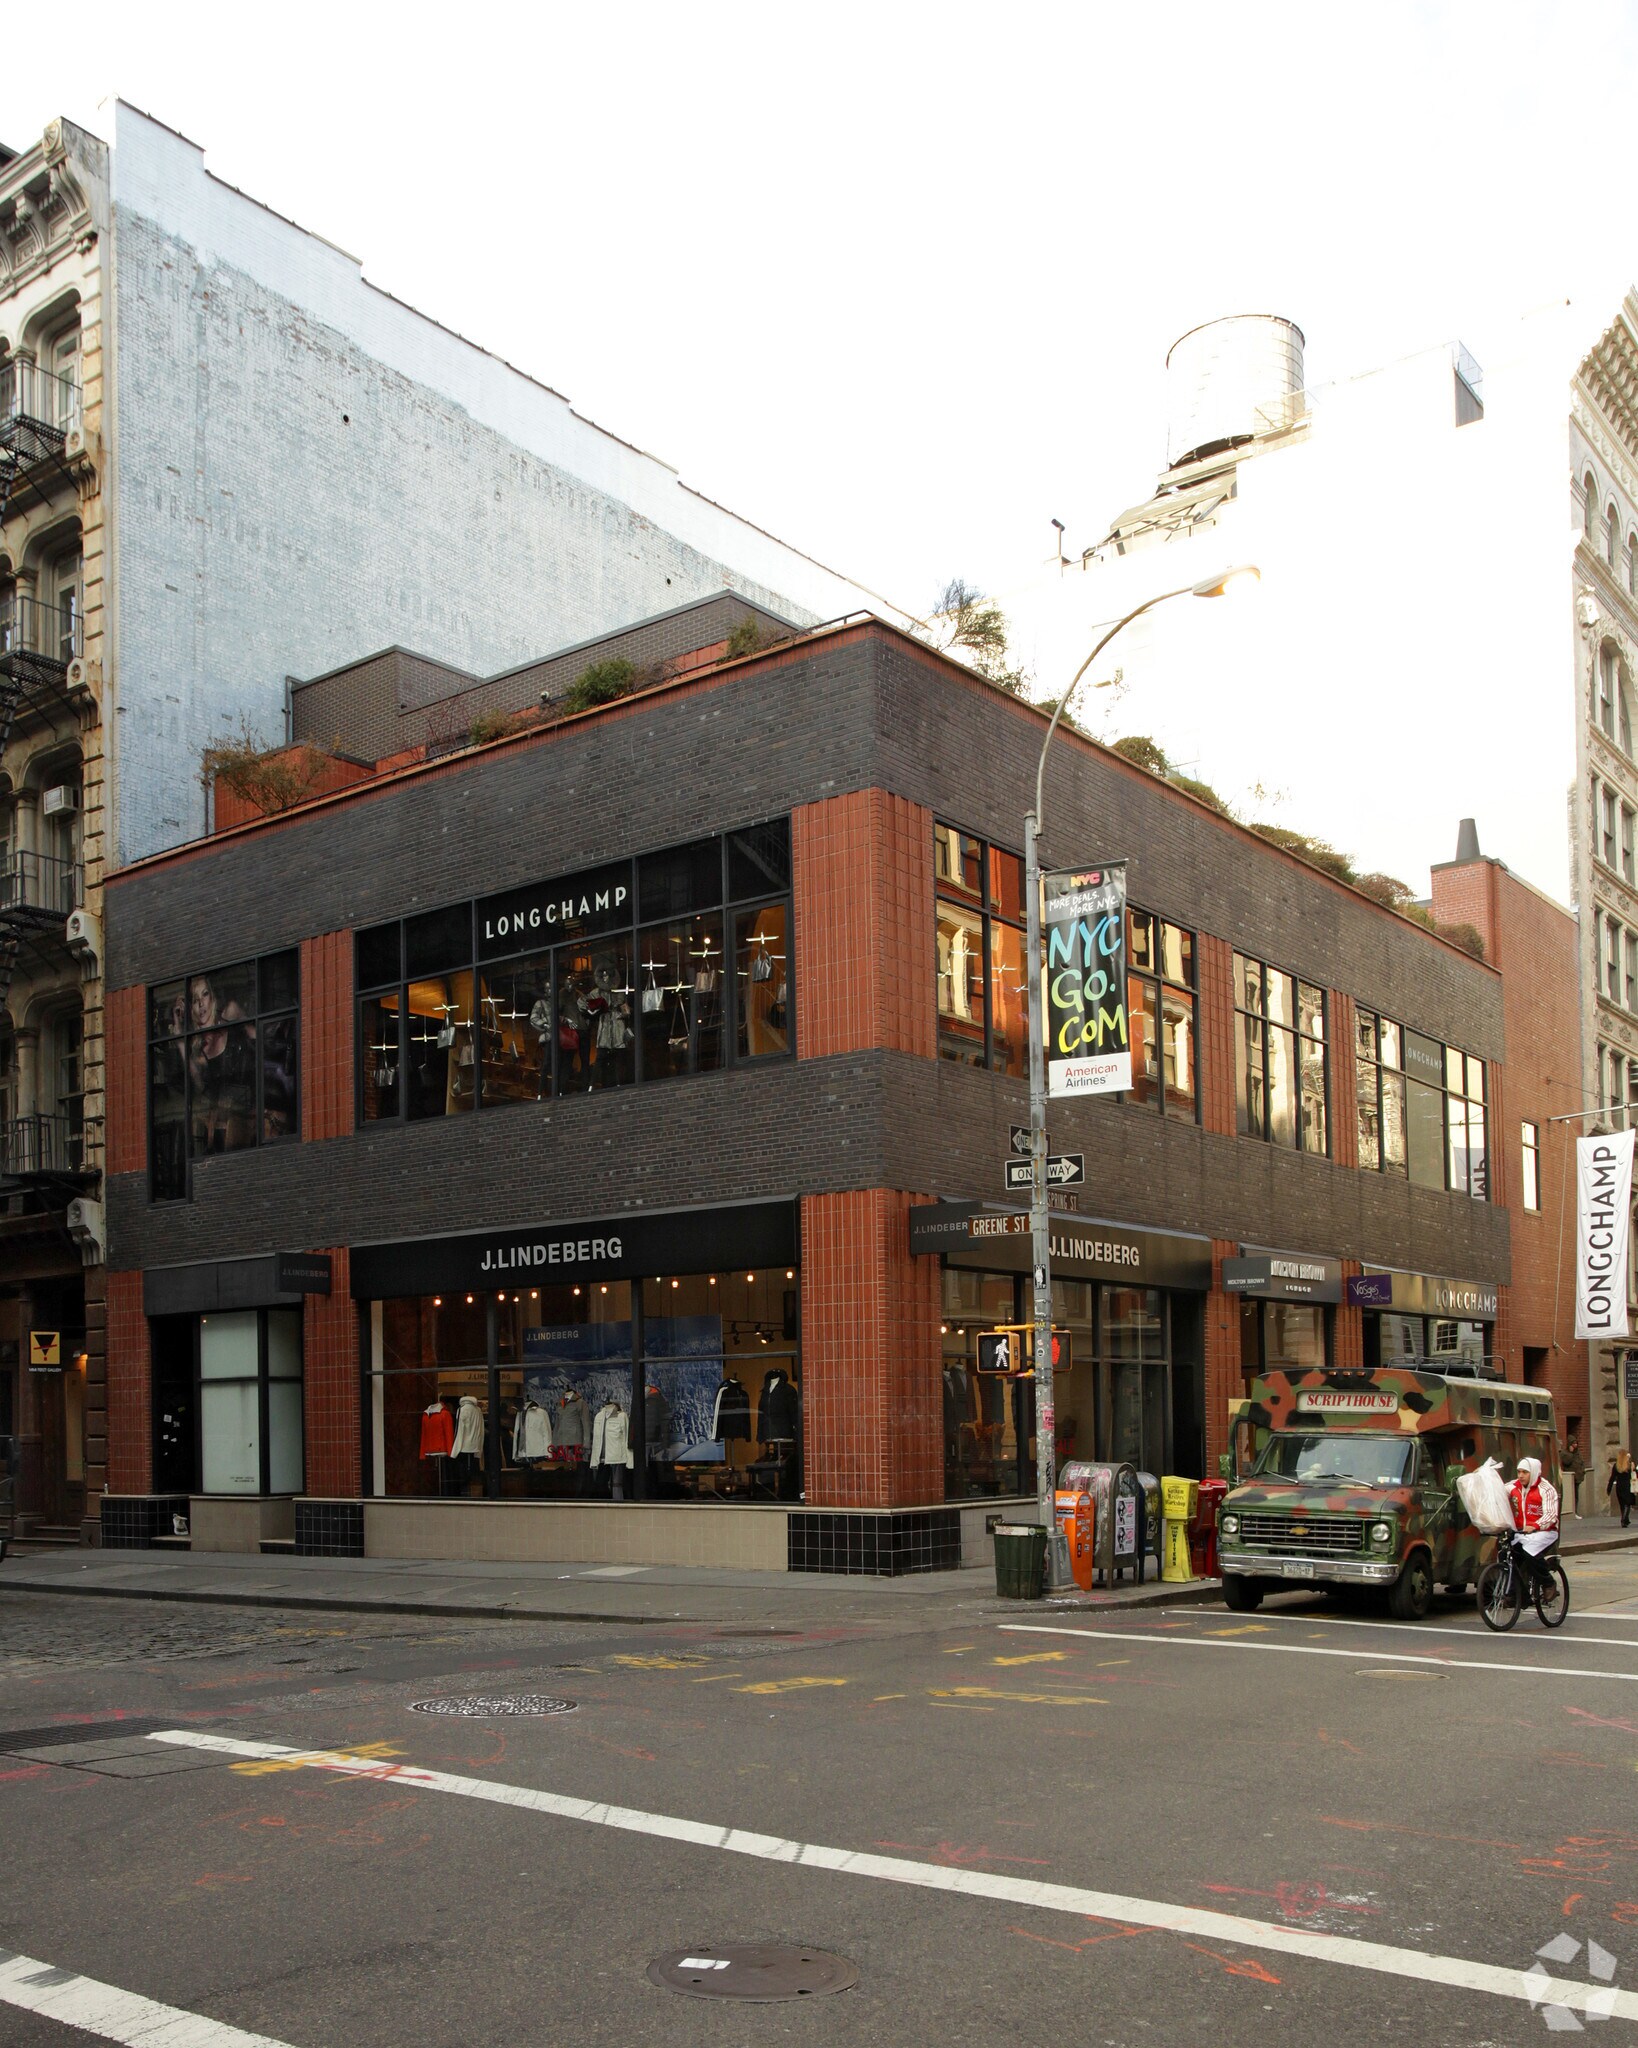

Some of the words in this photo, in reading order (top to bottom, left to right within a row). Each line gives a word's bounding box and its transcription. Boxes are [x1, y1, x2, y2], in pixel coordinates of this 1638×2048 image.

[1071, 872, 1100, 887] NYC
[1049, 896, 1070, 912] MORE
[1072, 890, 1100, 906] DEALS.
[1069, 902, 1094, 918] MORE
[1096, 895, 1119, 910] NYC
[485, 886, 627, 939] LONGCHAMP
[1049, 915, 1121, 969] NYC
[1051, 969, 1116, 1013] GO.
[1405, 1047, 1442, 1071] ONGCHAMP
[1065, 1064, 1118, 1078] American
[1065, 1076, 1107, 1088] Airlines
[1016, 1135, 1029, 1148] ONE
[1017, 1168, 1032, 1180] ON
[1049, 1164, 1072, 1177] WAY
[1047, 1191, 1068, 1210] SPRING
[1070, 1195, 1077, 1211] ST
[914, 1221, 968, 1235] J.LINDEBER
[972, 1217, 1009, 1236] GREENE
[1014, 1215, 1026, 1233] ST
[1587, 1145, 1617, 1329] LONGCHAMP
[481, 1237, 623, 1271] J.LINDEBERG
[1048, 1236, 1140, 1266] J.LINDEBERG
[1350, 1279, 1380, 1299] Vosges
[1435, 1288, 1497, 1313] LONGCHAMP
[526, 1330, 579, 1342] J.LINDEBERG
[467, 1373, 511, 1381] J.LINDRG
[1306, 1393, 1395, 1408] SCRIPTHOUSE
[547, 1444, 584, 1461] SALE
